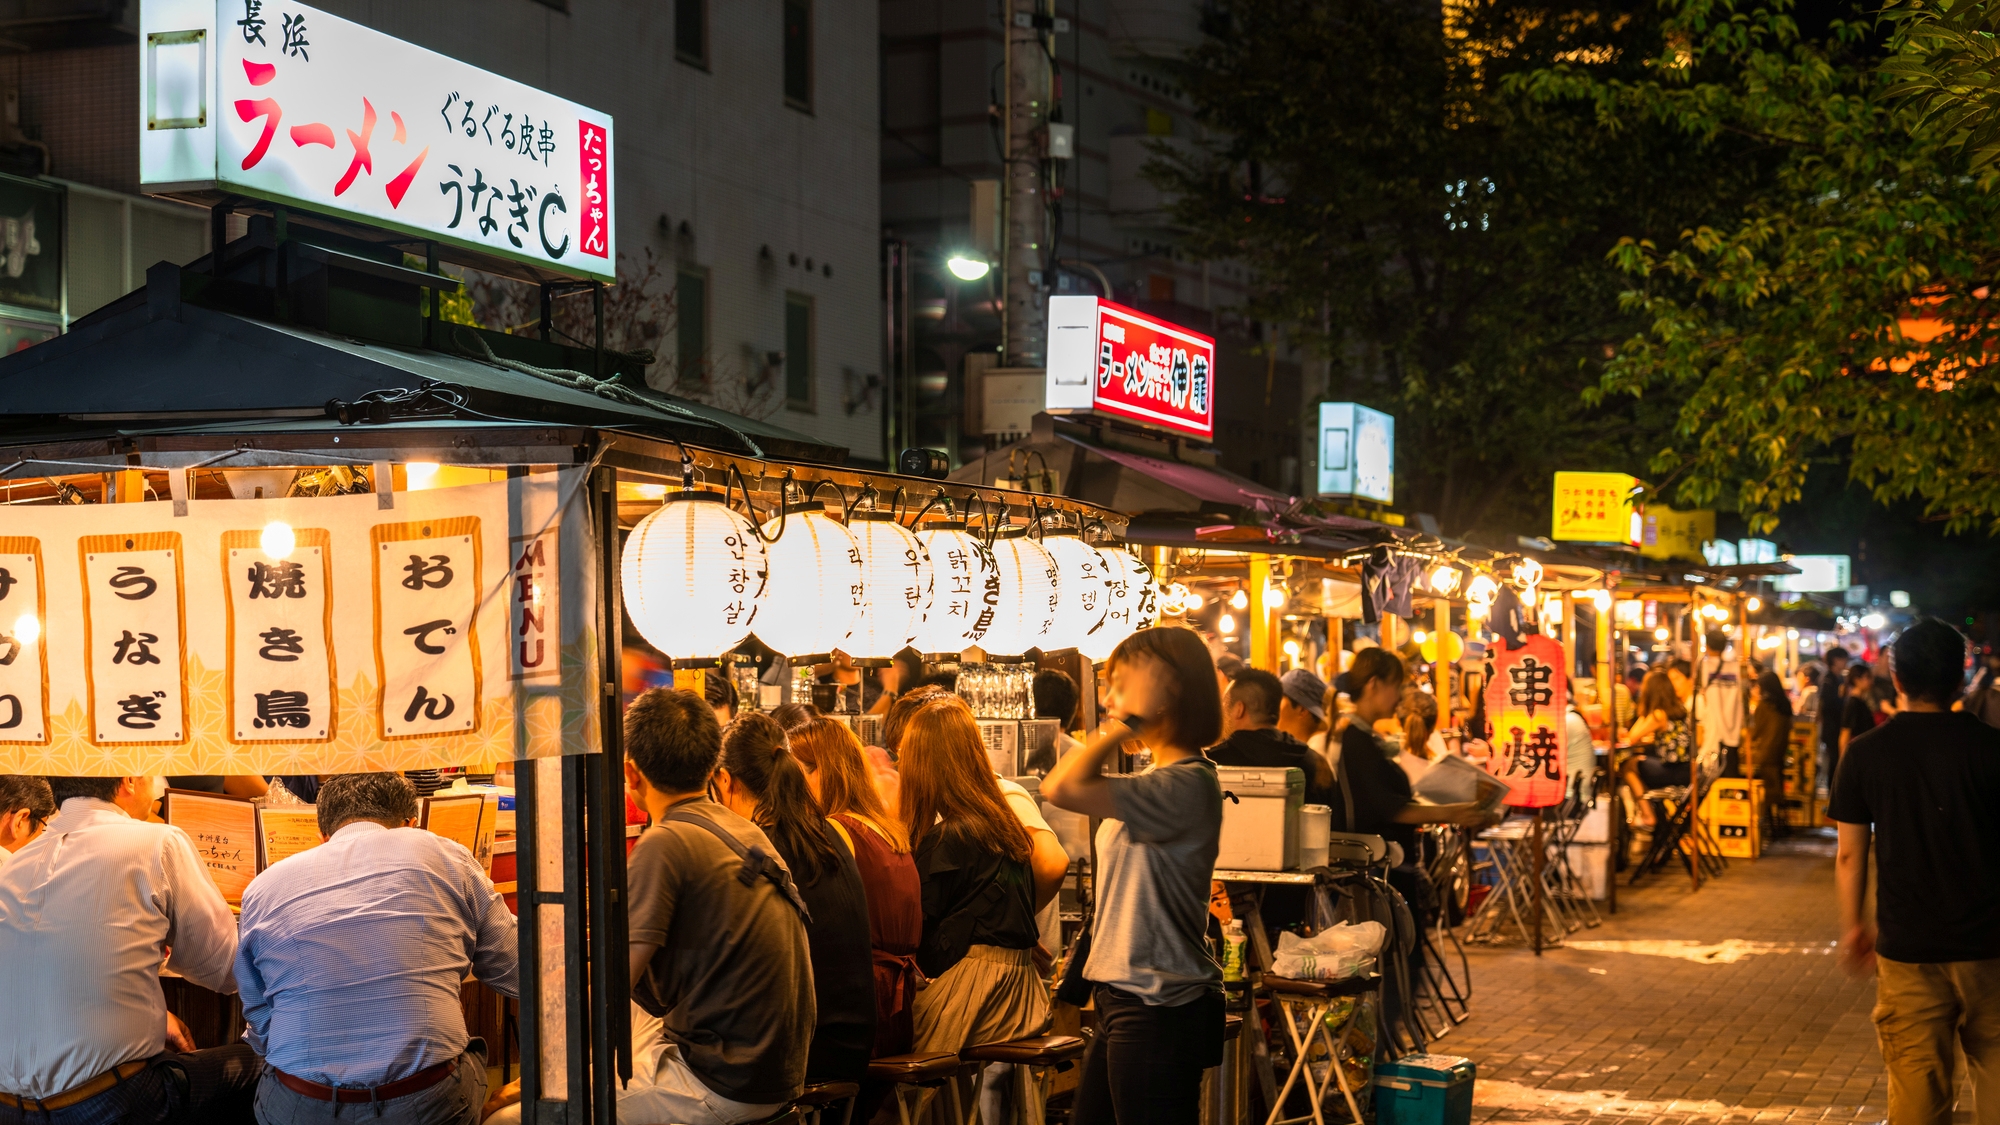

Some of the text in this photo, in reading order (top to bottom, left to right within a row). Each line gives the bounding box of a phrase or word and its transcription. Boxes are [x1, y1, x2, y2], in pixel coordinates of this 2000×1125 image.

[237, 0, 310, 62] 長浜
[234, 57, 429, 210] ラーメン
[440, 91, 556, 168] ぐるぐる皮串
[583, 128, 605, 253] たっちゃん
[1100, 341, 1149, 397] ラーメン
[515, 539, 546, 668] MENU
[722, 532, 750, 625] 안창살
[947, 549, 971, 619] 닭꼬치
[1080, 562, 1098, 612] 오뎅
[1110, 579, 1130, 625] 장어
[109, 565, 168, 729] うなぎ
[248, 560, 310, 729] 焼き鳥
[402, 553, 456, 723] おでん
[1504, 657, 1560, 780] 串焼
[199, 845, 244, 862] っちゃん
